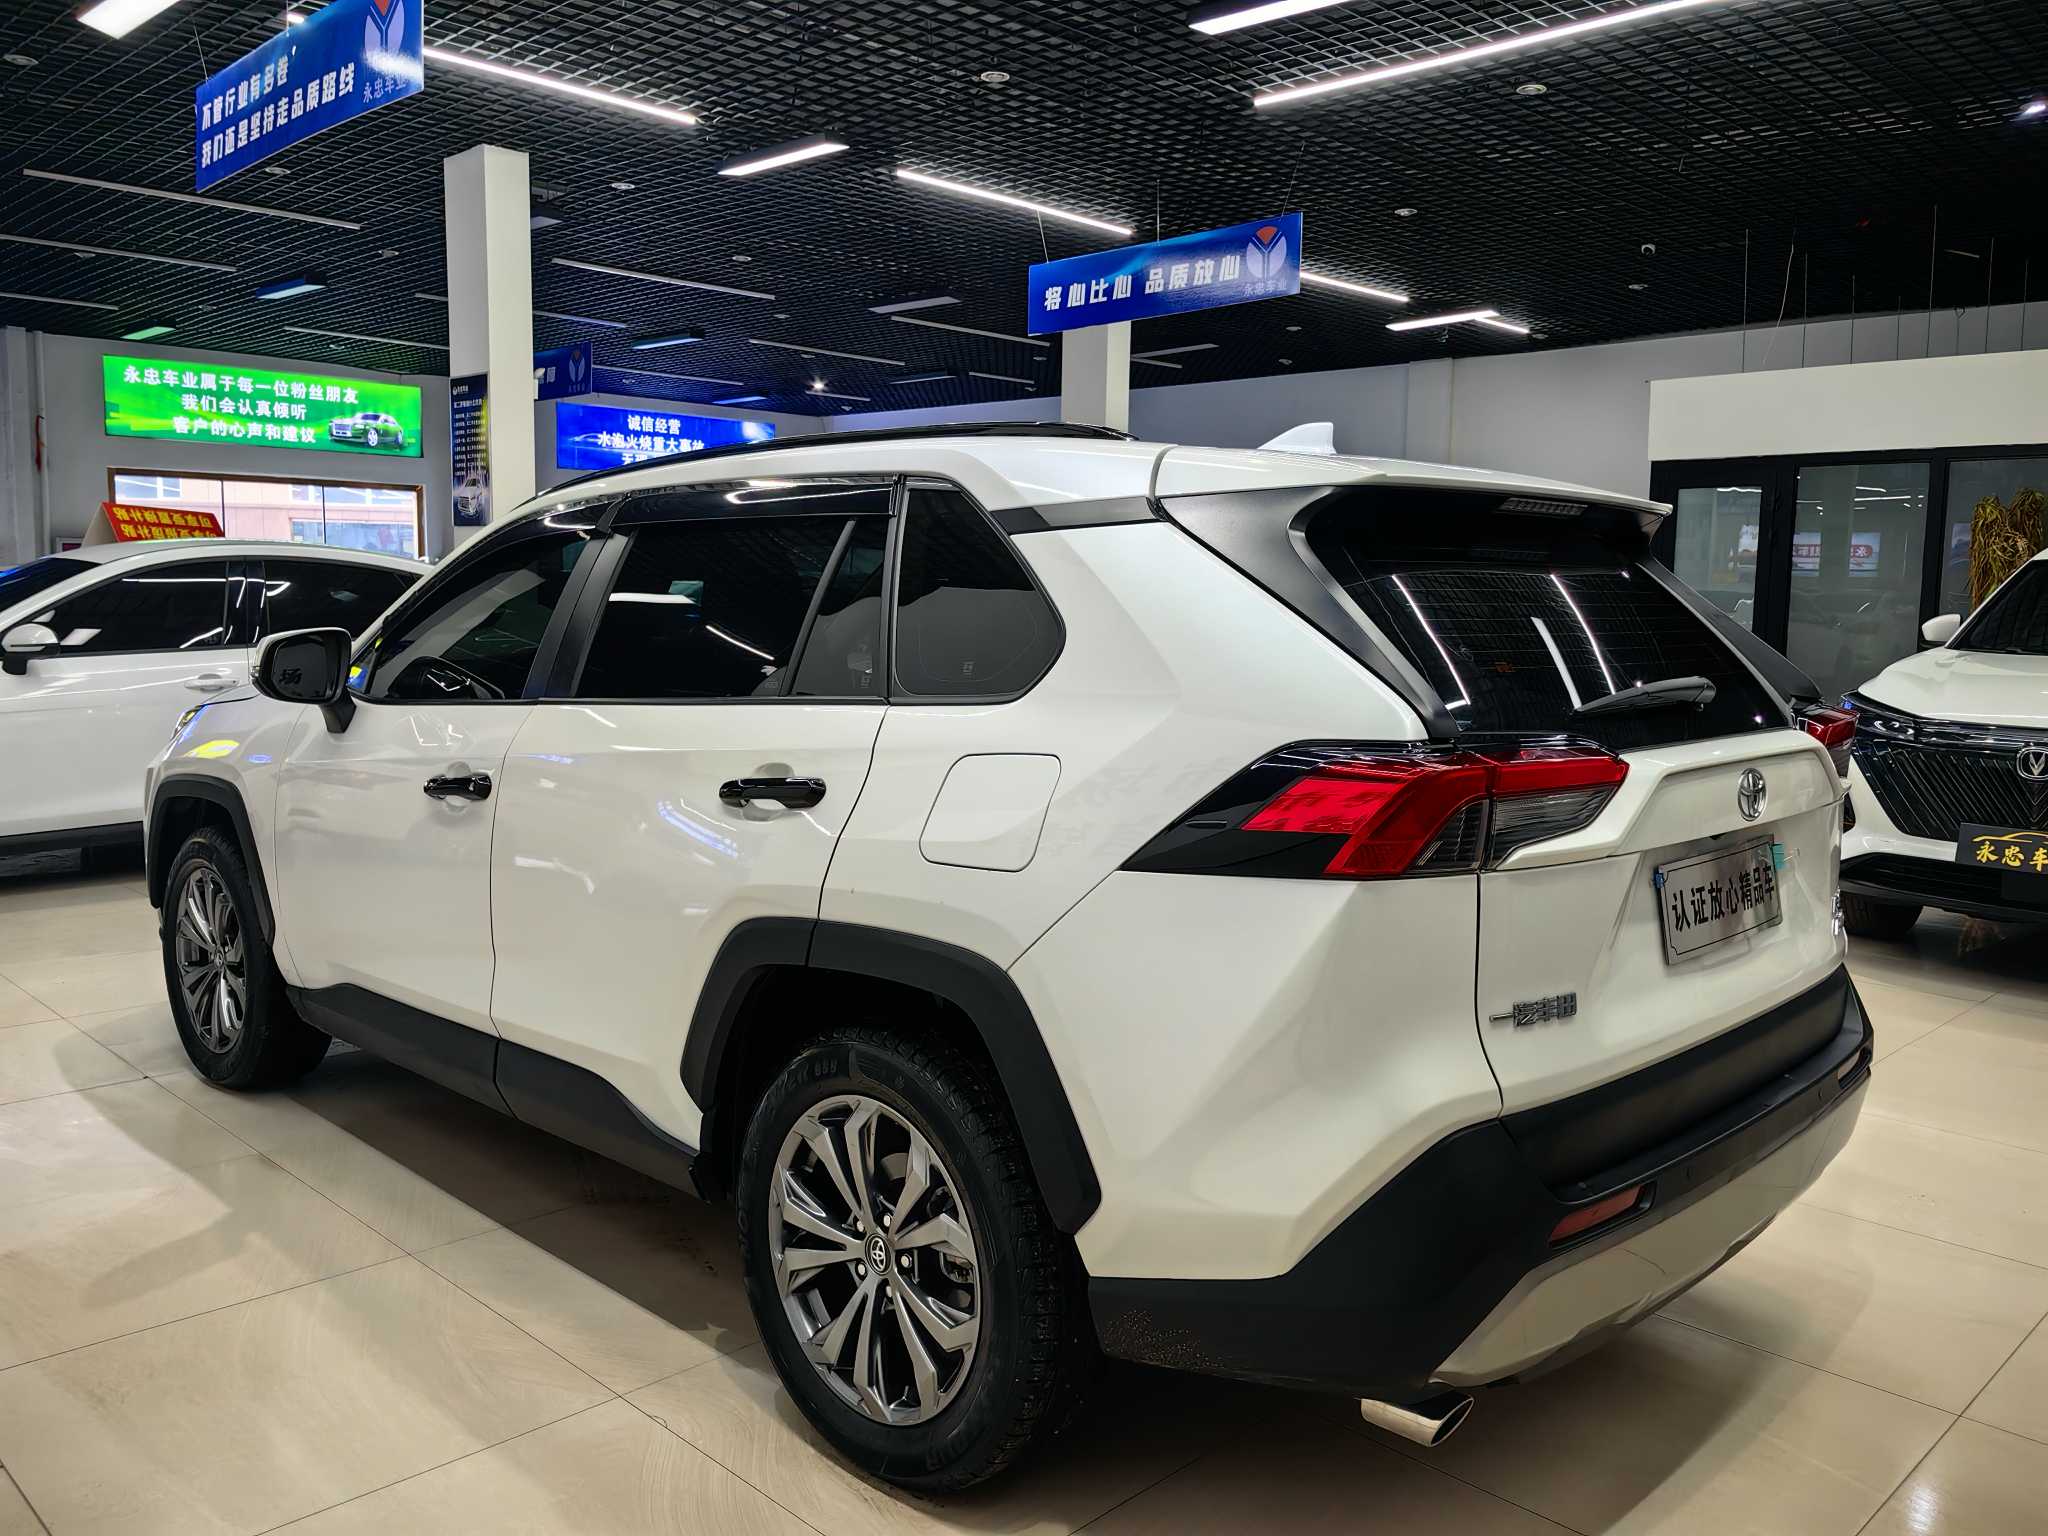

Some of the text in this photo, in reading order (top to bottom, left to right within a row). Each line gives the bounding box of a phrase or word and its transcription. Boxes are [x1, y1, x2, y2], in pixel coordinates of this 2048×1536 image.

[201, 62, 356, 169] 我们还是坚持走品质路线
[1044, 254, 1241, 311] 将心比心 品质放心
[123, 365, 359, 405] 永忠车业属于每一位粉丝朋友
[181, 393, 308, 420] 我们会认真倾听
[627, 413, 681, 436] 诚信经营
[172, 416, 317, 444] 客户的心声和建议
[1672, 861, 1775, 932] 认证放心精品车
